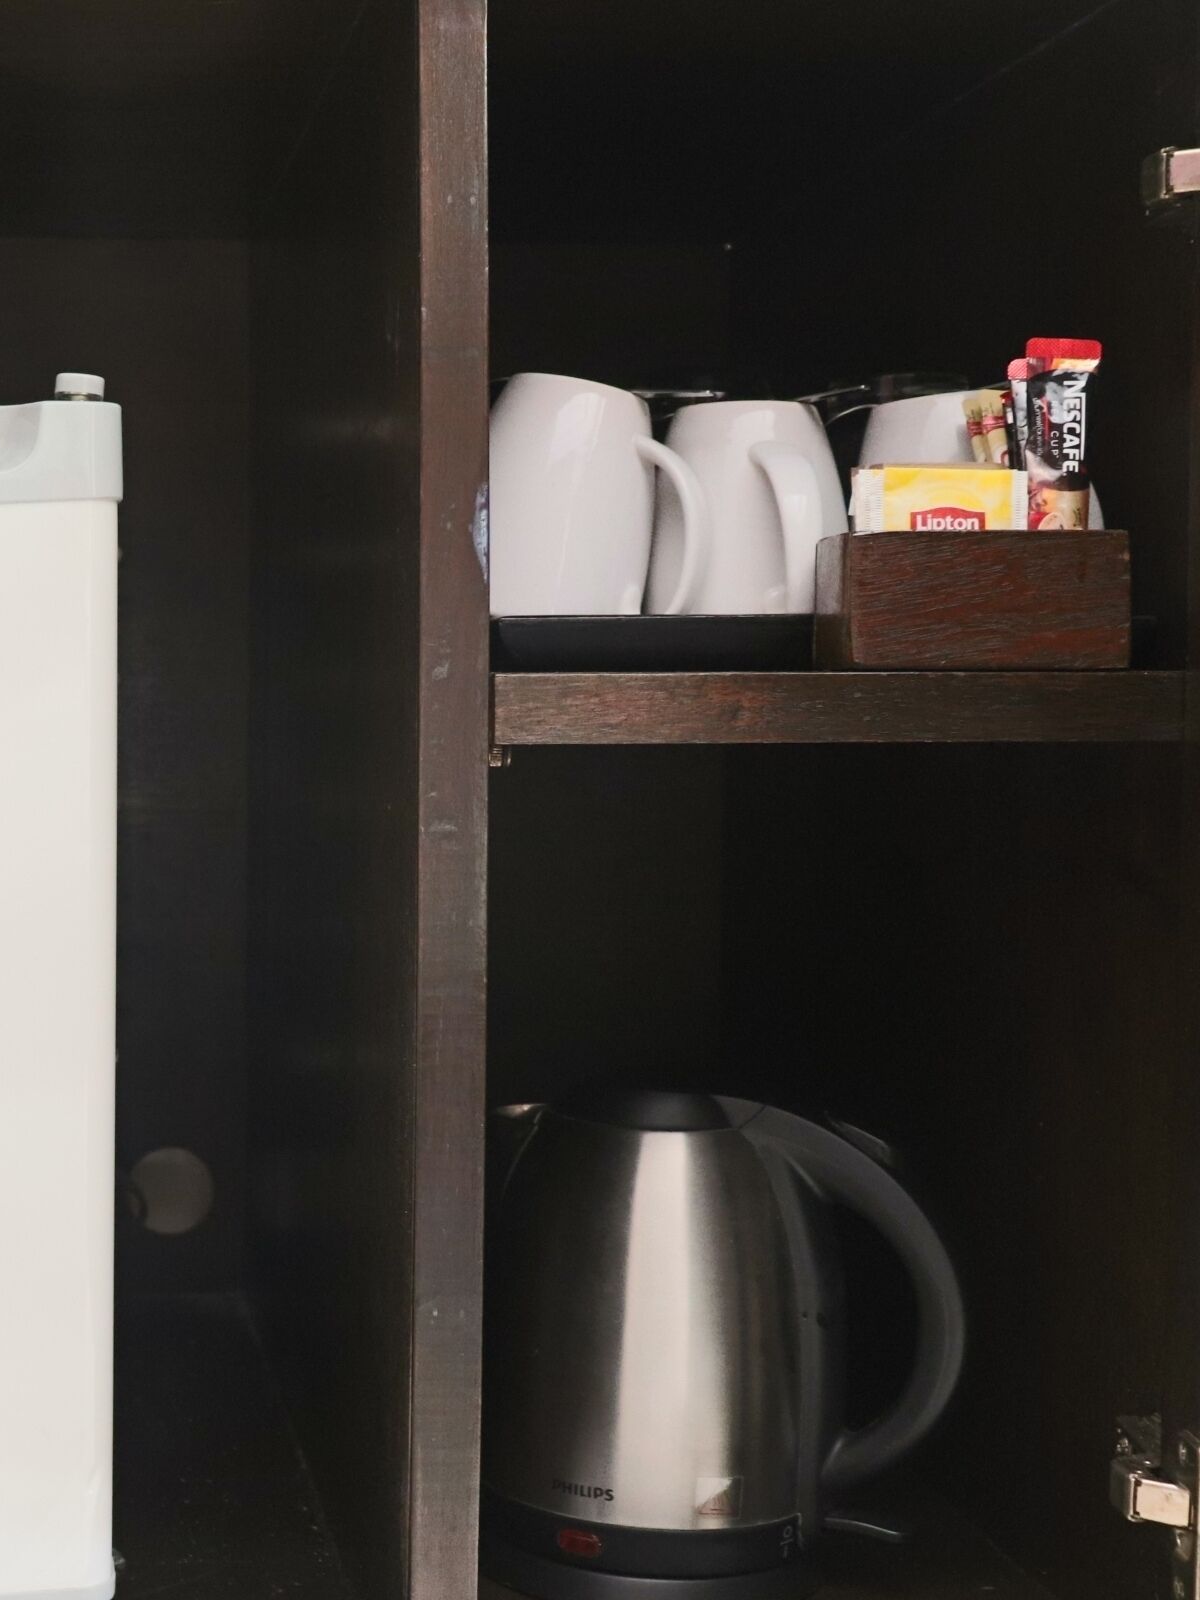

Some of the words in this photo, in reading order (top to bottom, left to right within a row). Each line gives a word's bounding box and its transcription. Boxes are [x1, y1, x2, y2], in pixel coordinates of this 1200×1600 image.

[1050, 430, 1060, 456] CUP
[915, 513, 980, 532] Lipton
[551, 1479, 615, 1502] PHILIPS
